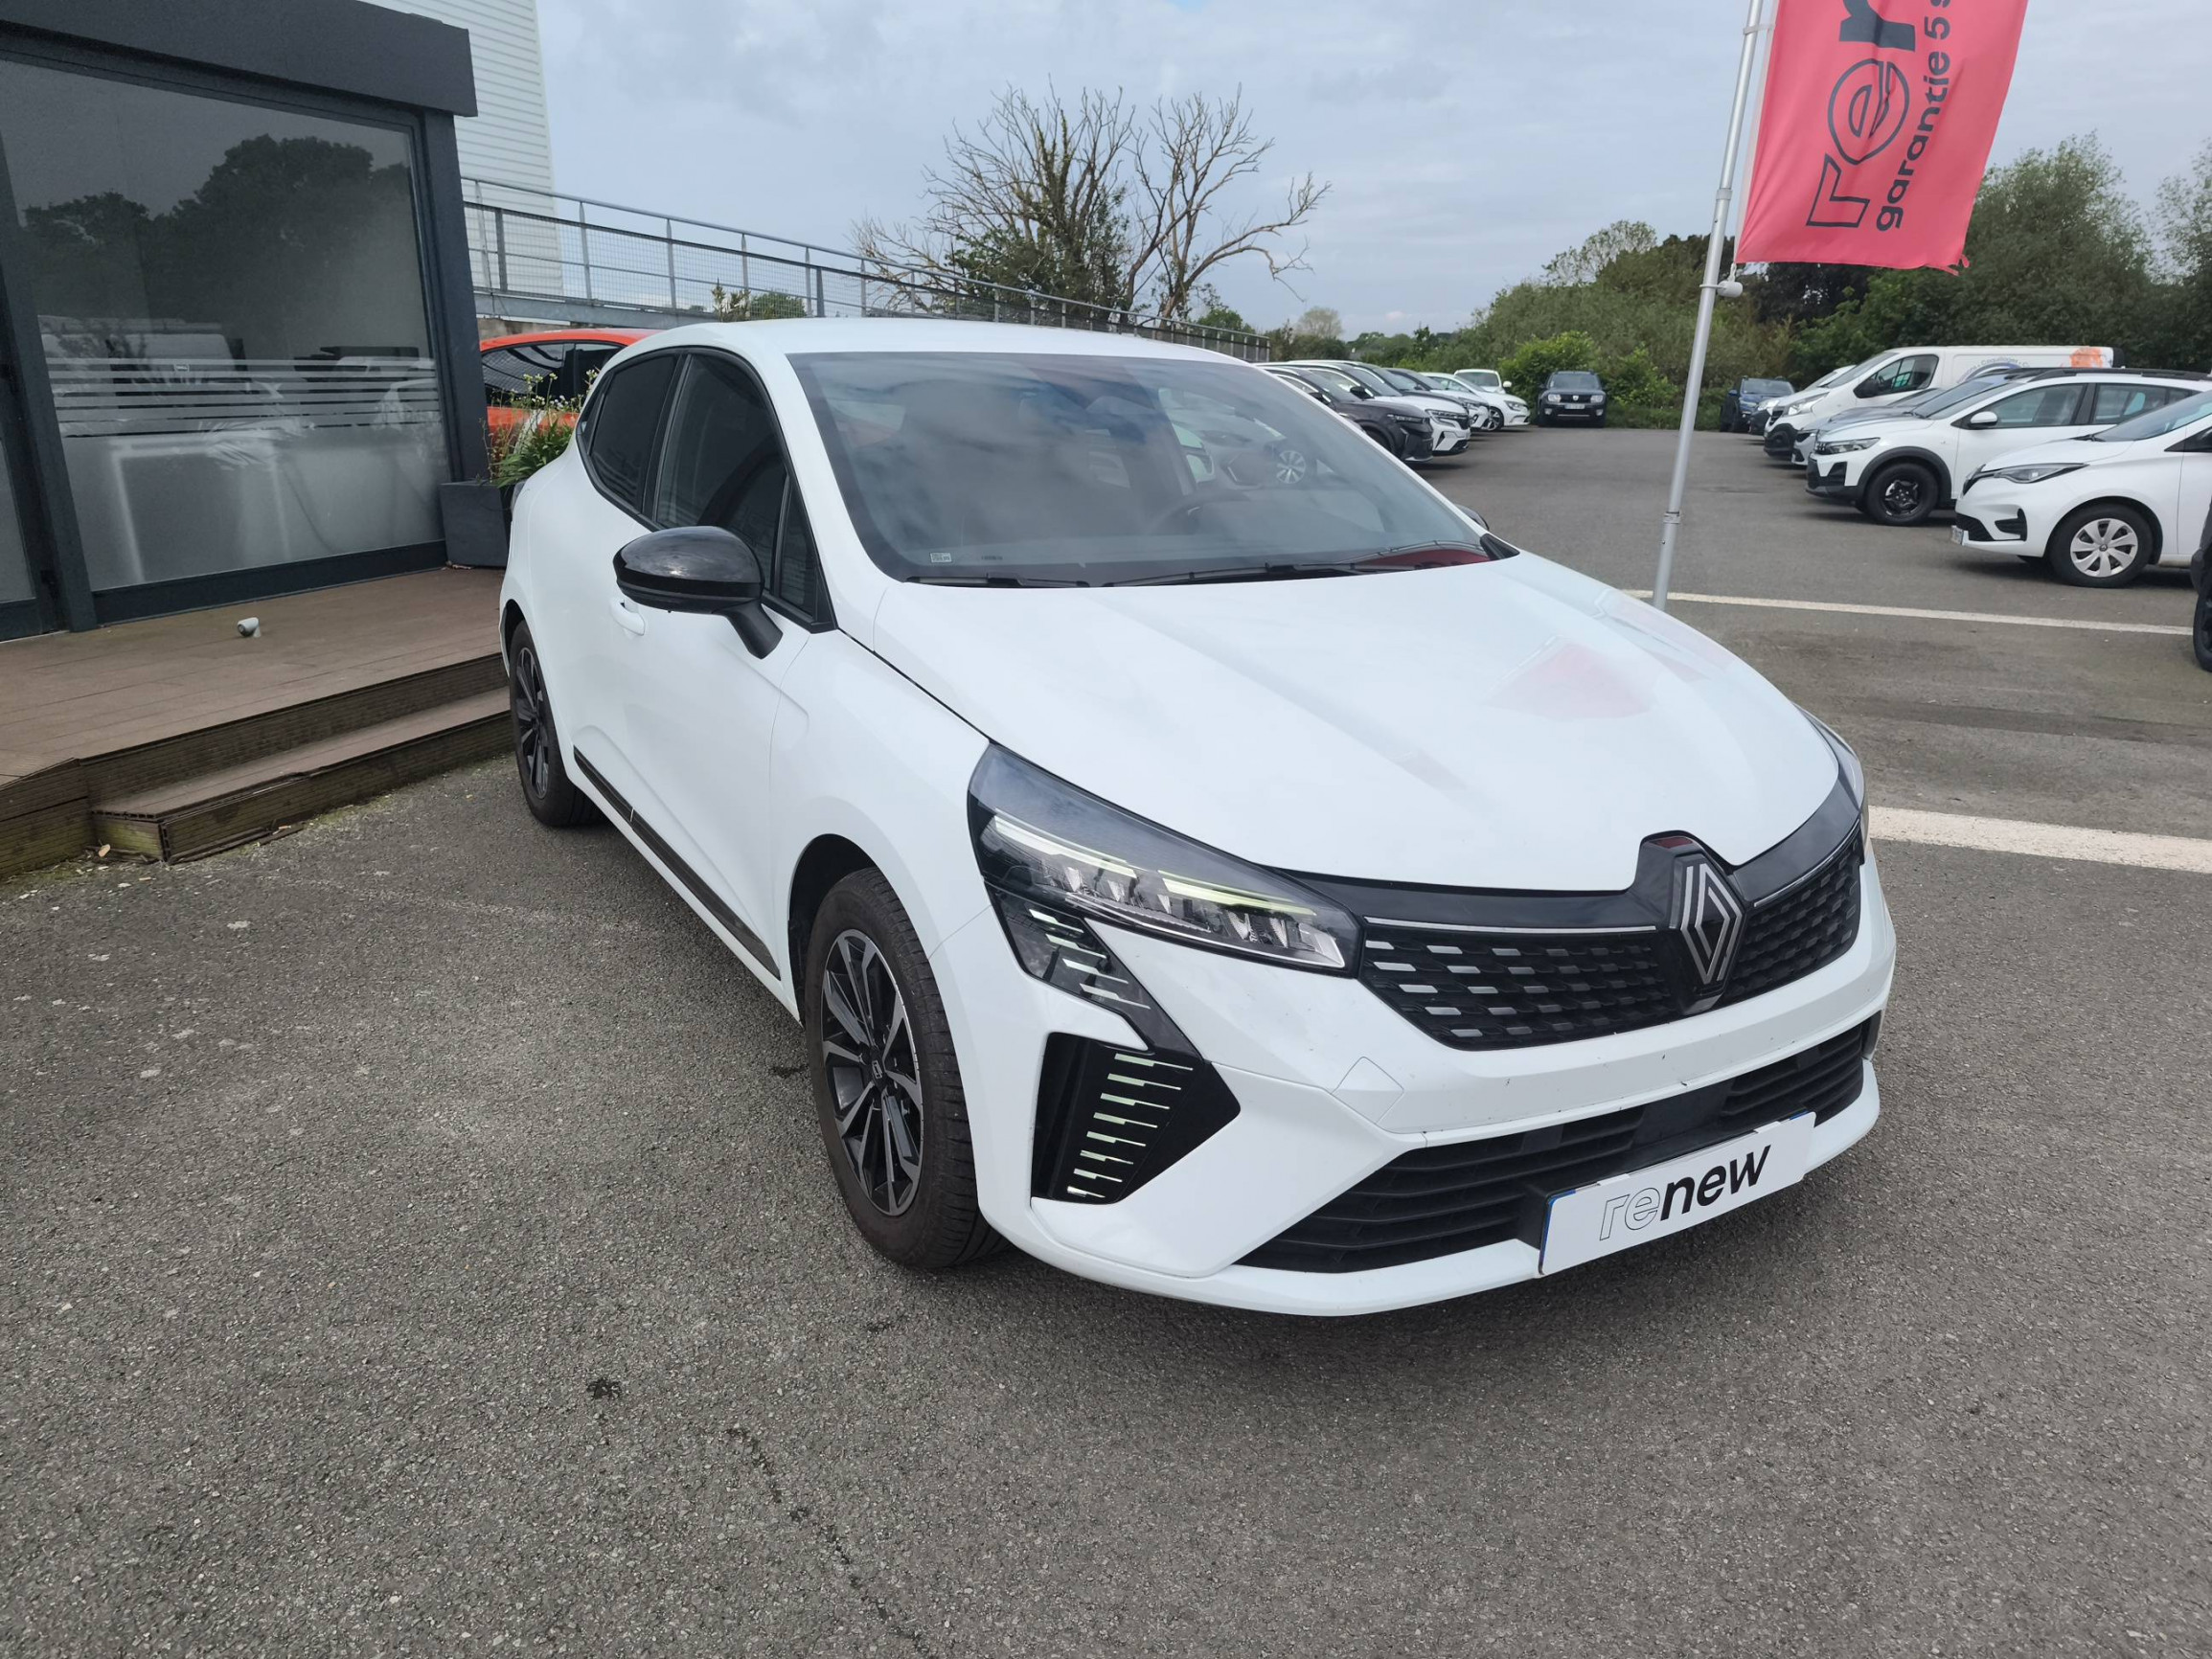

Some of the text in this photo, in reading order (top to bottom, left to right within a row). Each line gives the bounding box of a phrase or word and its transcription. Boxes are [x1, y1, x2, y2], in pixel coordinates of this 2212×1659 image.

[1876, 15, 1950, 232] garantie 5
[1599, 1144, 1771, 1241] renew
